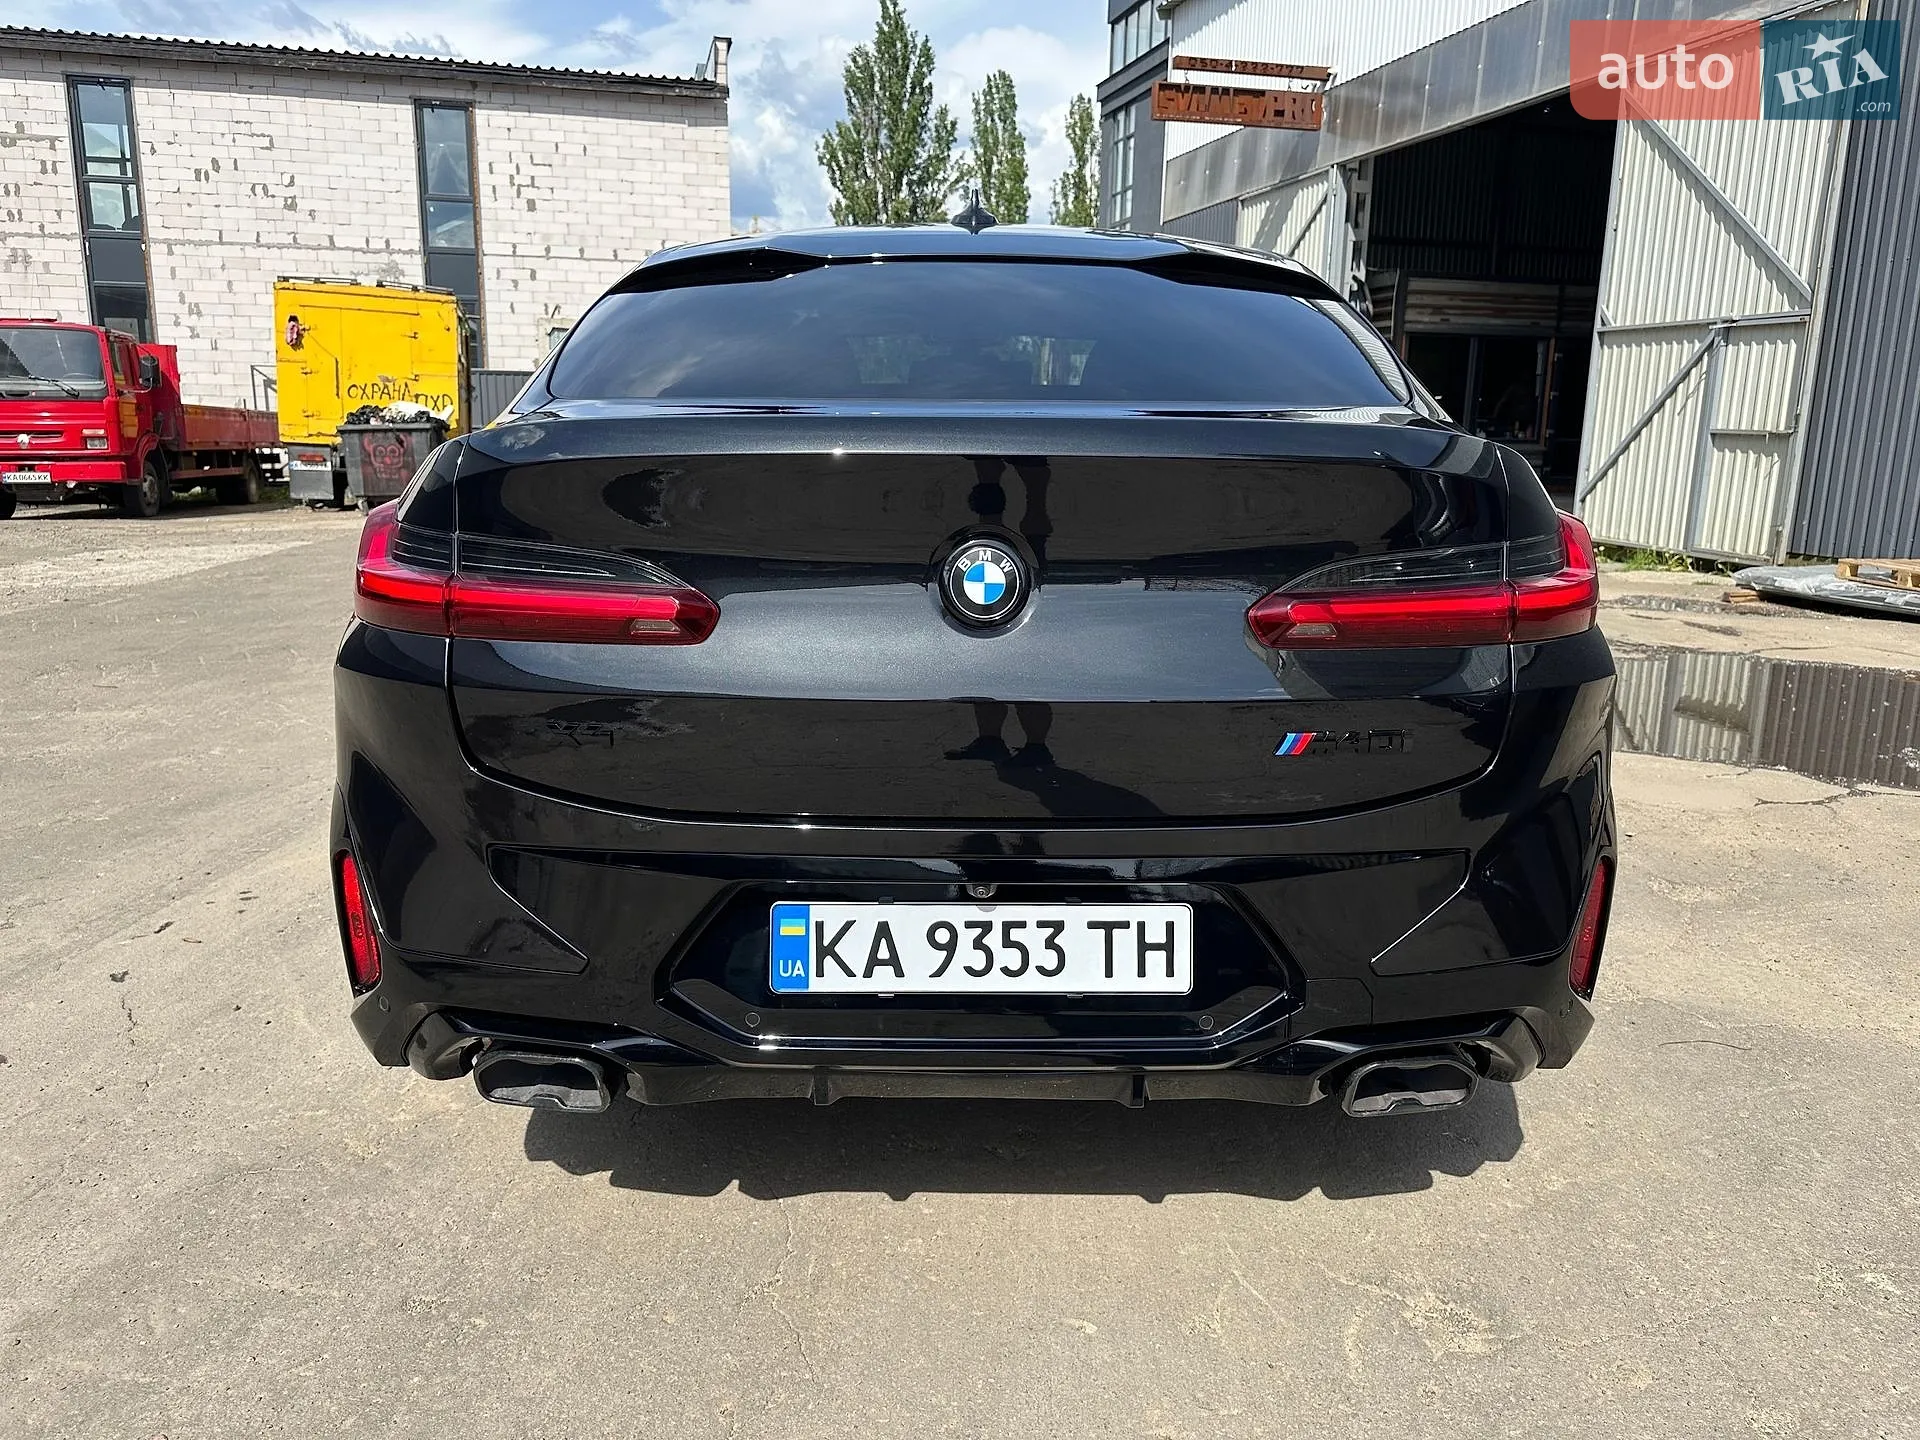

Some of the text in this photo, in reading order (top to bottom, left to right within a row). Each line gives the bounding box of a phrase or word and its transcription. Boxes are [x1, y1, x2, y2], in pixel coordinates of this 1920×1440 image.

[957, 550, 1014, 573] BMW
[814, 919, 1176, 979] KA 9353 TH
[779, 960, 806, 978] UA
